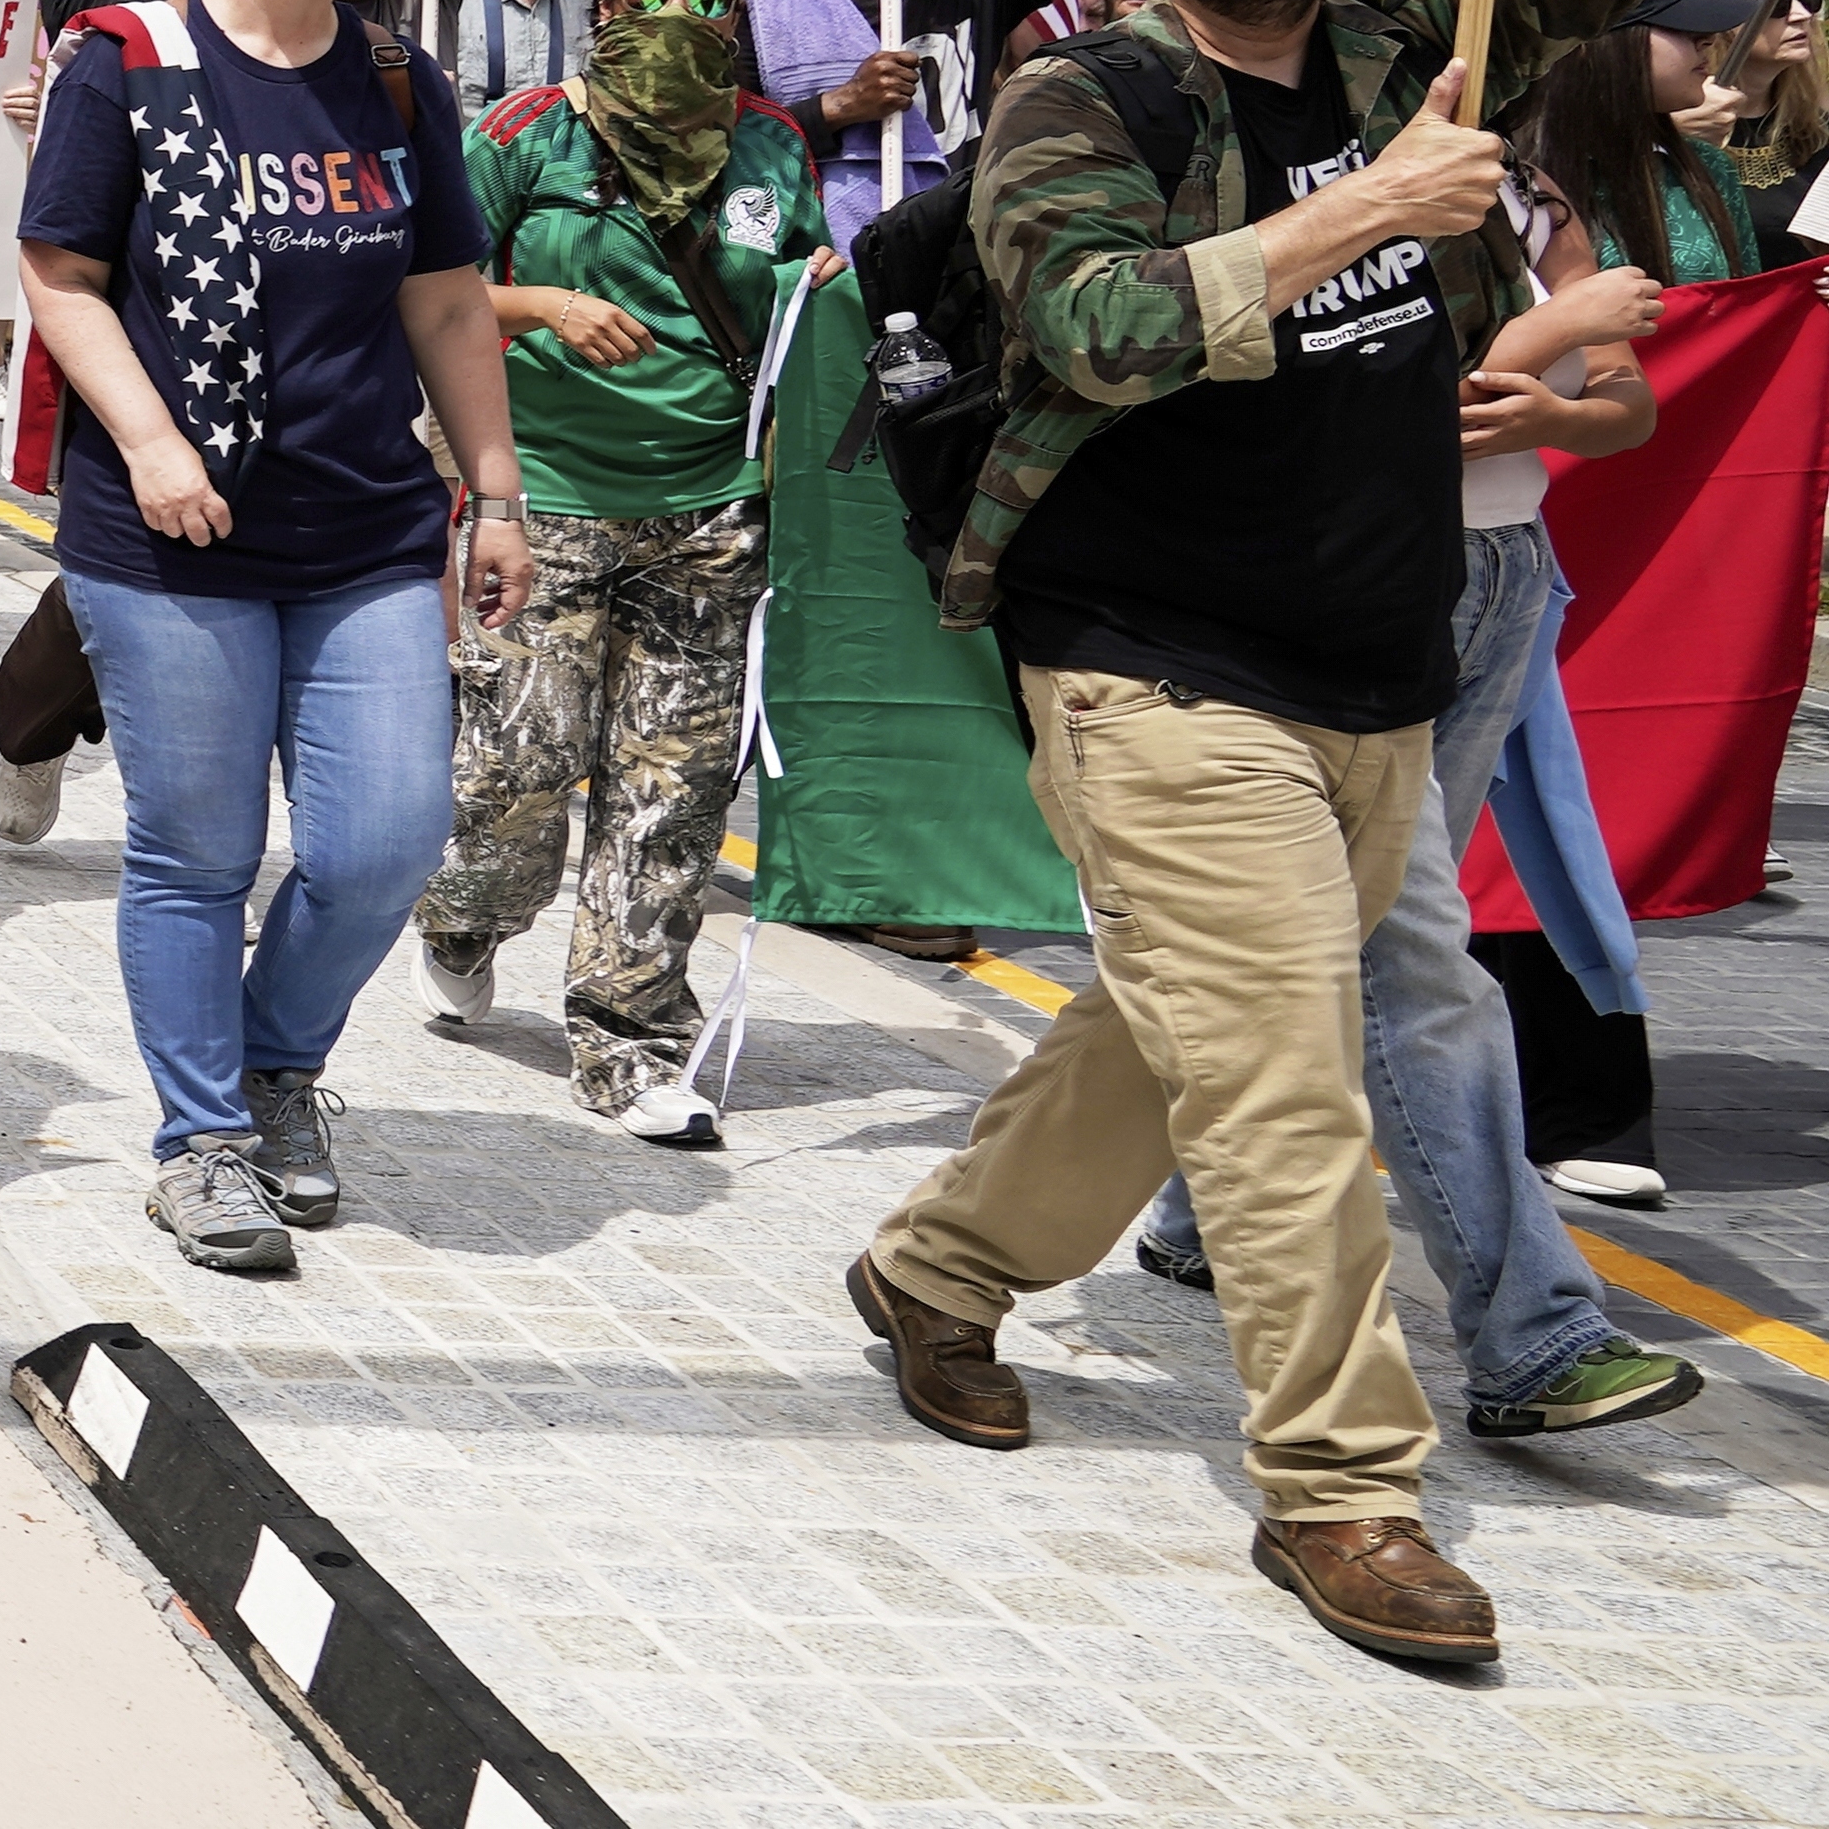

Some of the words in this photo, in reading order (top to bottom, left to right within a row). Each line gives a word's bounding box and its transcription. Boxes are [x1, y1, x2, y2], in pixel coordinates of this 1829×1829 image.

[227, 146, 414, 216] ISSENT
[265, 224, 332, 253] Bader
[334, 222, 406, 255] Ginsburg
